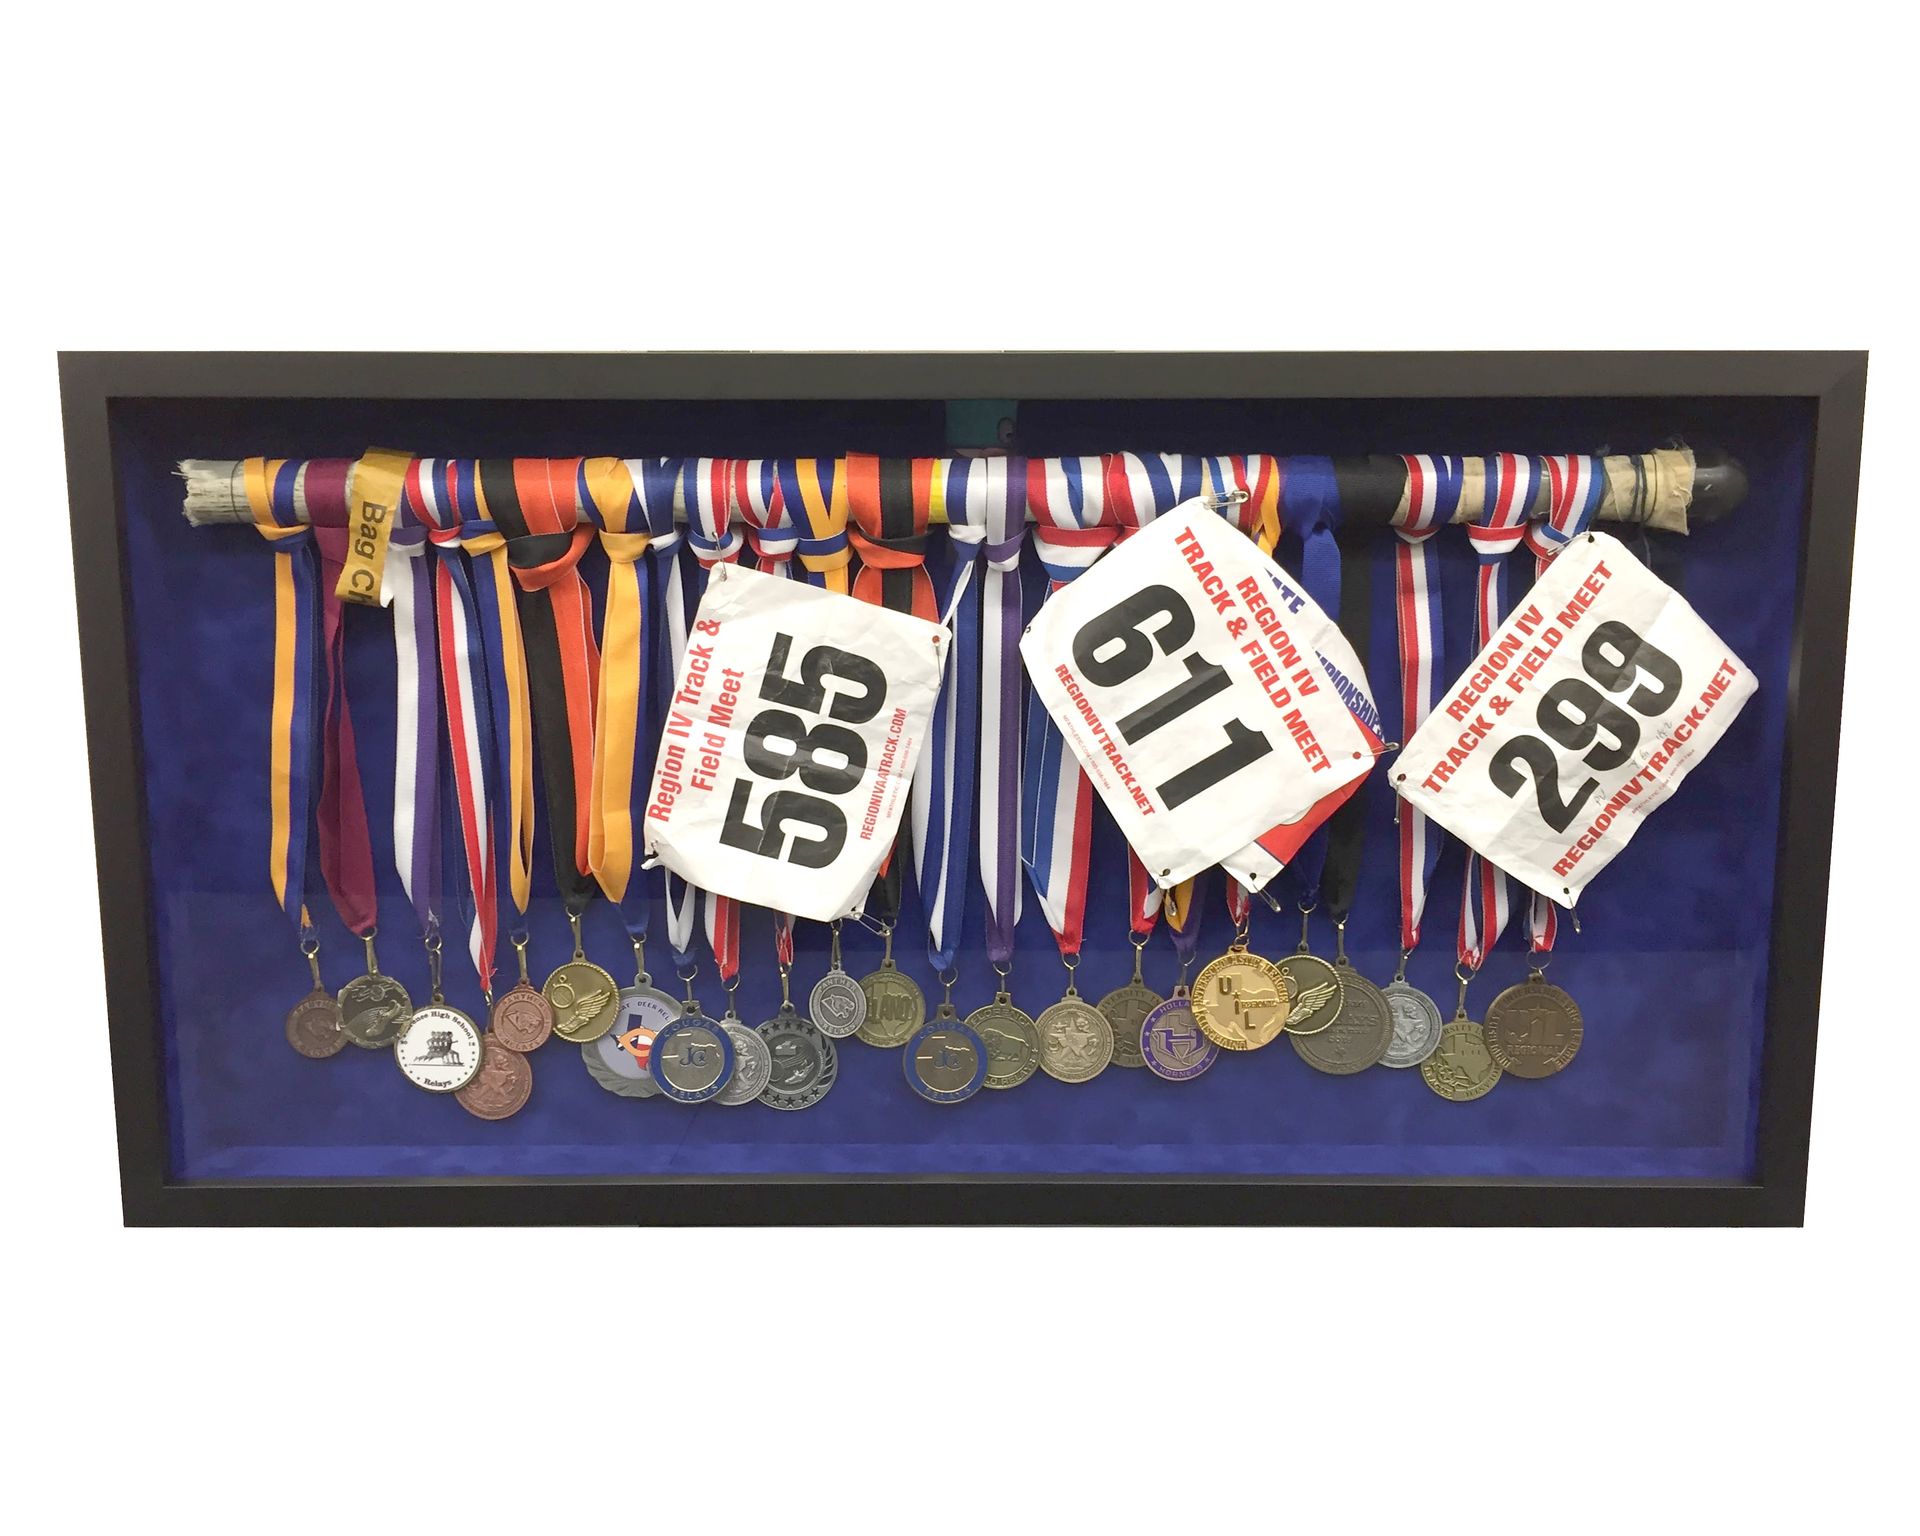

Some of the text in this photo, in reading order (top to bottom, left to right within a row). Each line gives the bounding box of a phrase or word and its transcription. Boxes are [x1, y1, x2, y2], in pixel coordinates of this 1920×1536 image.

[354, 501, 387, 560] Bag
[1072, 584, 1273, 811] 611
[1174, 527, 1235, 616] TRACK
[1227, 617, 1248, 640] &
[1240, 640, 1291, 709] FIELD
[1282, 700, 1332, 774] MEET
[1236, 576, 1302, 669] REGION
[1291, 665, 1320, 698] IV
[1421, 560, 1614, 794] TRACK & FIELD MEET
[1446, 604, 1546, 723] REGION IV
[648, 619, 722, 822] Region IV Track &
[691, 668, 745, 791] Field Meet
[719, 632, 888, 869] 585
[860, 708, 907, 840] REGIONIVAATRACK.COM
[1055, 664, 1156, 816] REGIONIVTRACK.NET
[1488, 620, 1683, 834] 299
[1552, 658, 1738, 878] REGIONIVTRACK.NET
[430, 1011, 451, 1019] High
[1159, 1001, 1190, 1014] HOLLA
[423, 1076, 453, 1088] Relays
